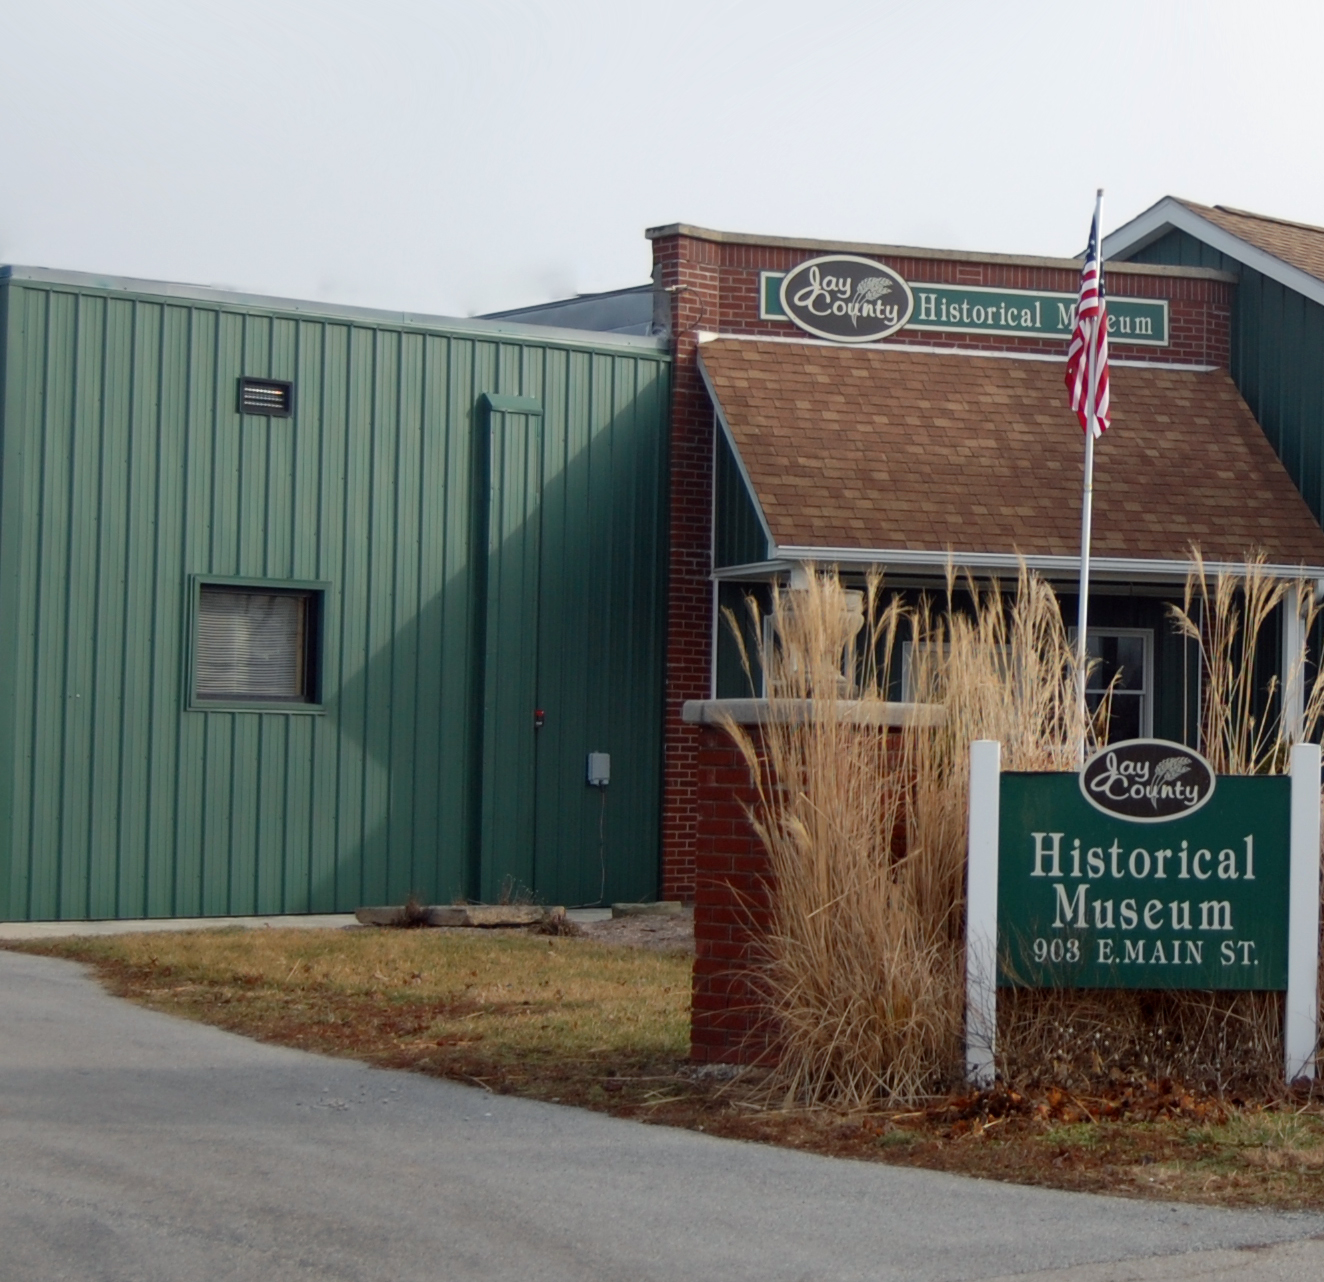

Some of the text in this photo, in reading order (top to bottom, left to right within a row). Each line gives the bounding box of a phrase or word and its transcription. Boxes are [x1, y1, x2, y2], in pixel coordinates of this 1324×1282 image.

[794, 265, 852, 307] Jay
[807, 289, 899, 326] County
[918, 293, 1153, 335] Historical Meum
[1090, 751, 1150, 792] Jay
[1104, 774, 1199, 806] County
[1030, 831, 1256, 880] Historical
[1052, 883, 1234, 930] Museum
[1033, 938, 1259, 966] 903 E.MAIN ST.
